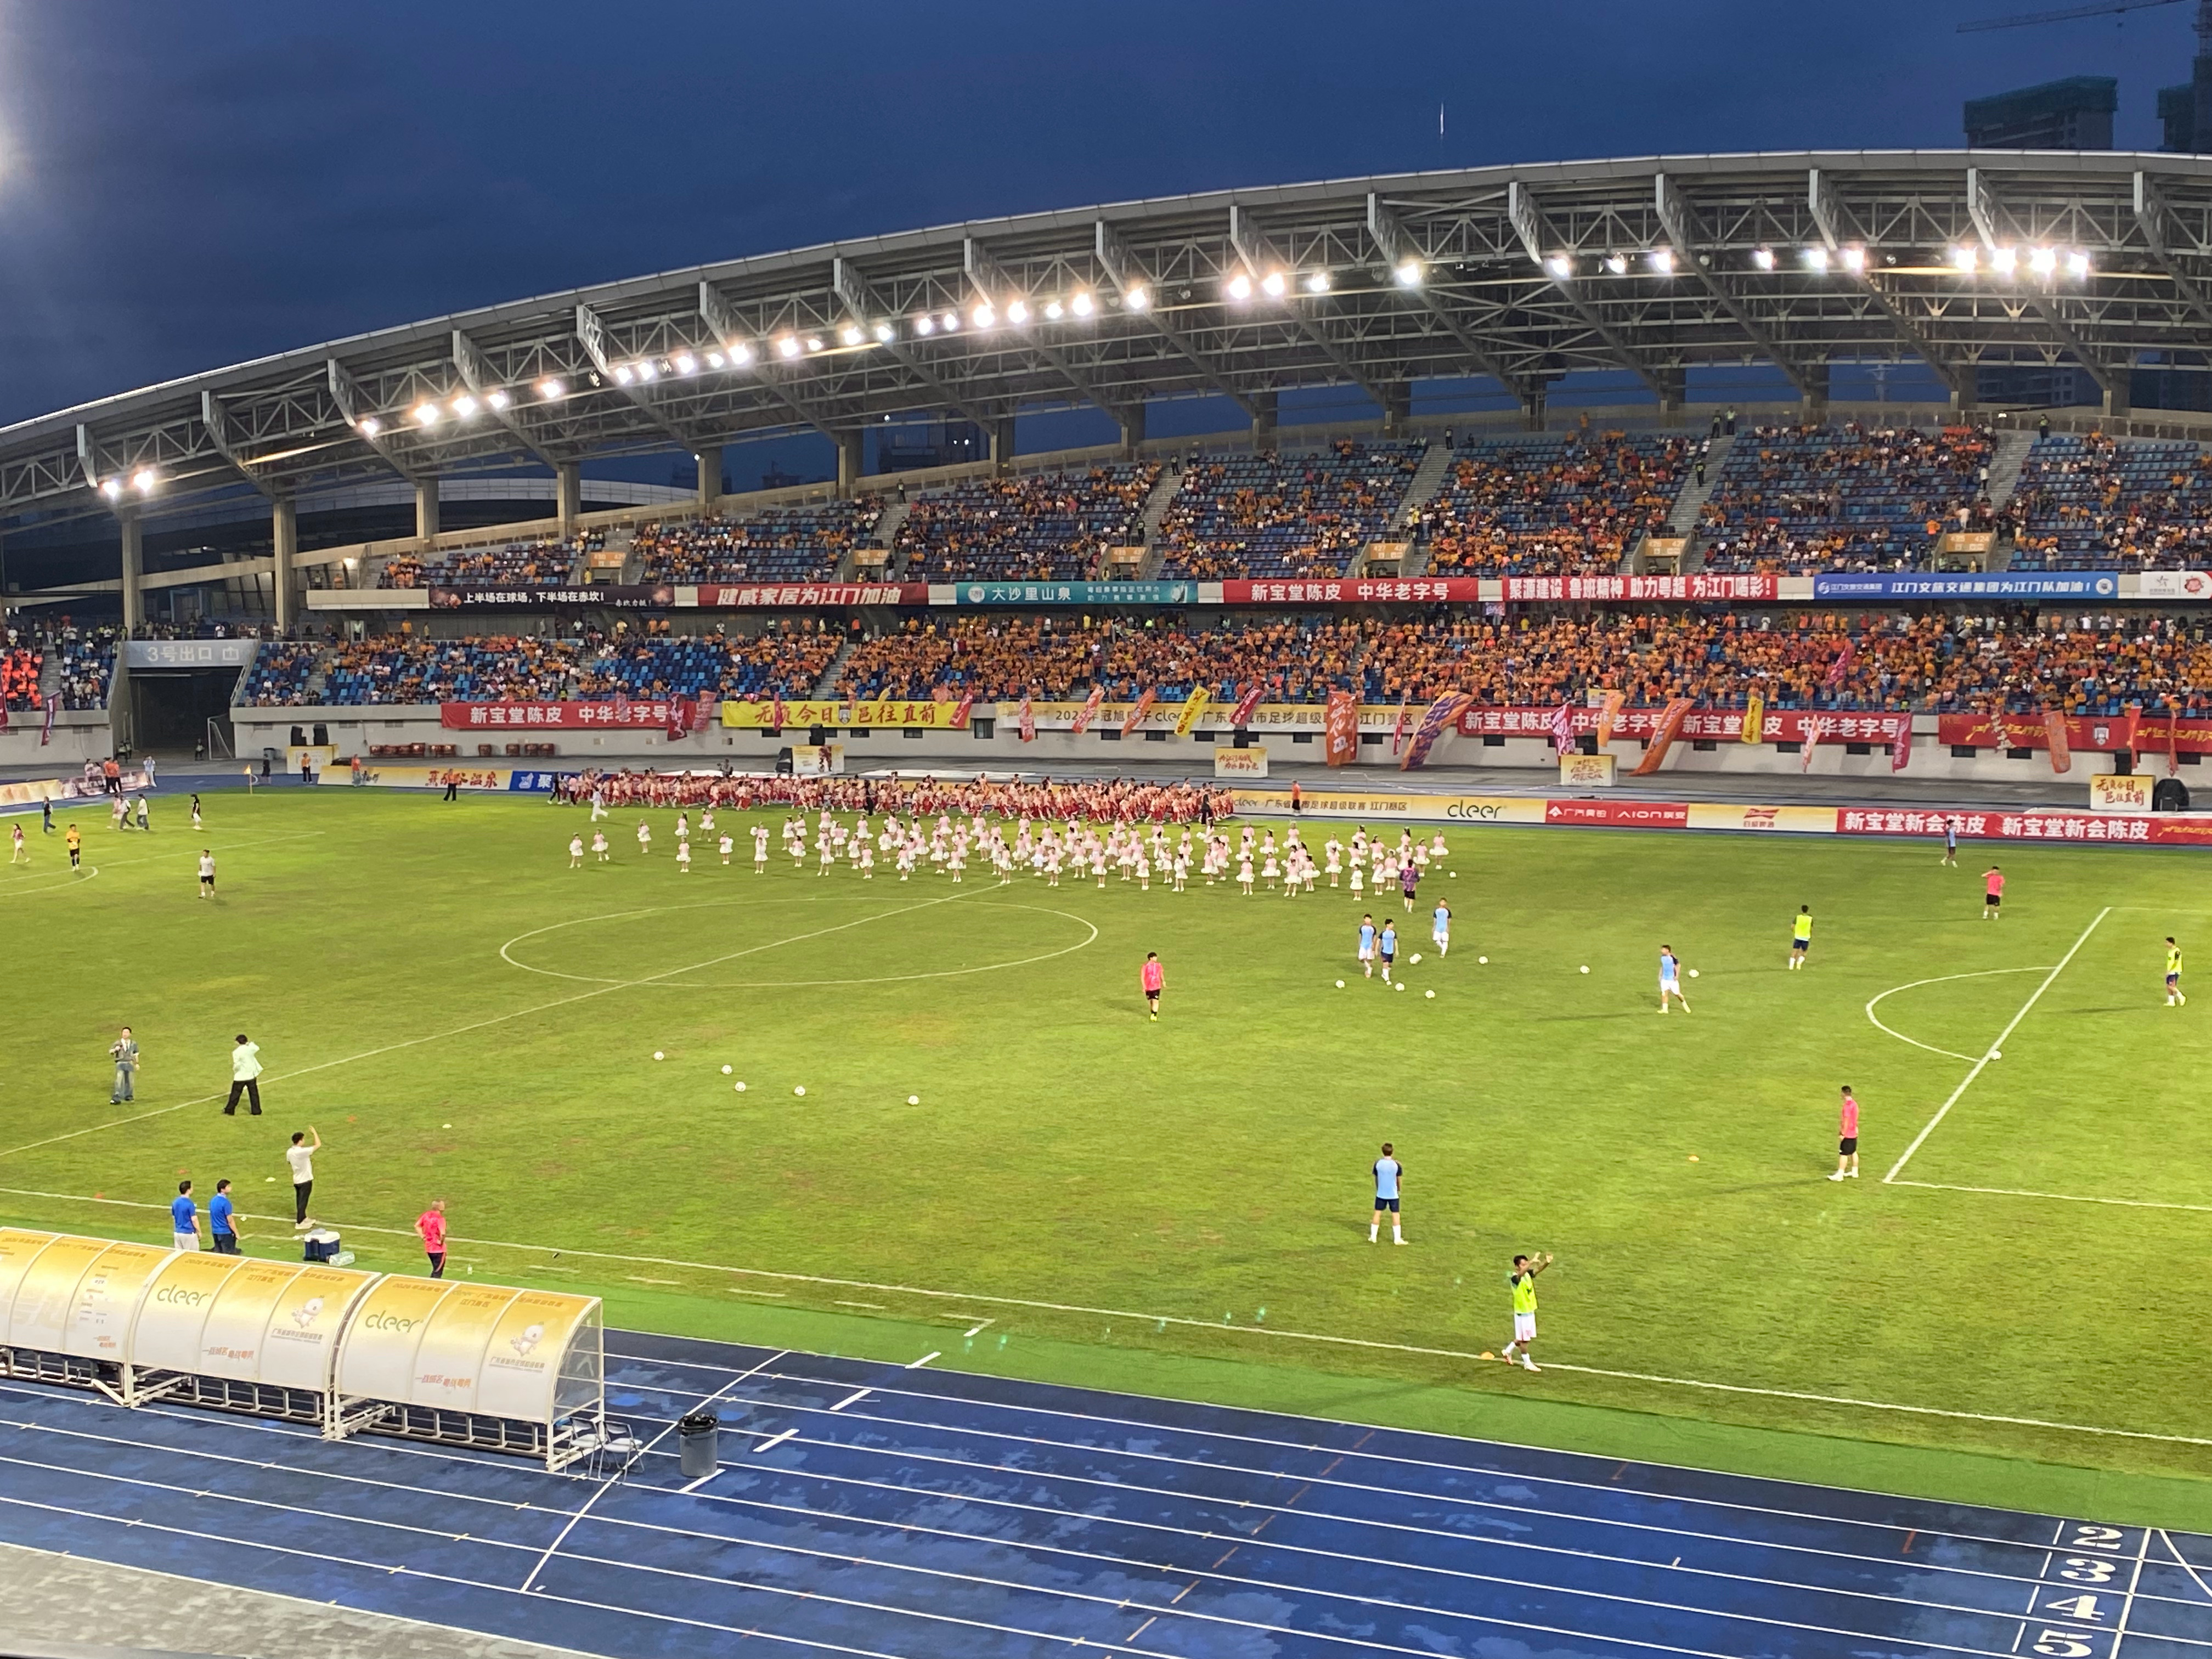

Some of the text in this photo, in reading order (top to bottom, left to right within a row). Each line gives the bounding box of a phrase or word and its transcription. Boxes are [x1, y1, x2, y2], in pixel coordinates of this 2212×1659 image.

[991, 586, 1071, 601] 大沙里山泉
[1251, 582, 1449, 601] 新宝堂陈皮 中华老字号
[147, 646, 213, 662] 3号出口
[470, 706, 563, 724] 新宝堂陈皮
[1682, 714, 1783, 736] 新宝堂皮
[1265, 799, 1367, 811] 广东省市足球超级联赛
[1447, 799, 1502, 819] cleer
[1845, 811, 1986, 834] 新宝堂新会陈皮
[2002, 816, 2150, 841] 新宝堂新会陈皮
[157, 1284, 208, 1307] cleer
[365, 1310, 420, 1333] cleer
[2073, 1526, 2123, 1550] 2
[2061, 1558, 2116, 1582] 3
[2045, 1595, 2105, 1621] 4
[2033, 1629, 2093, 1657] 5
